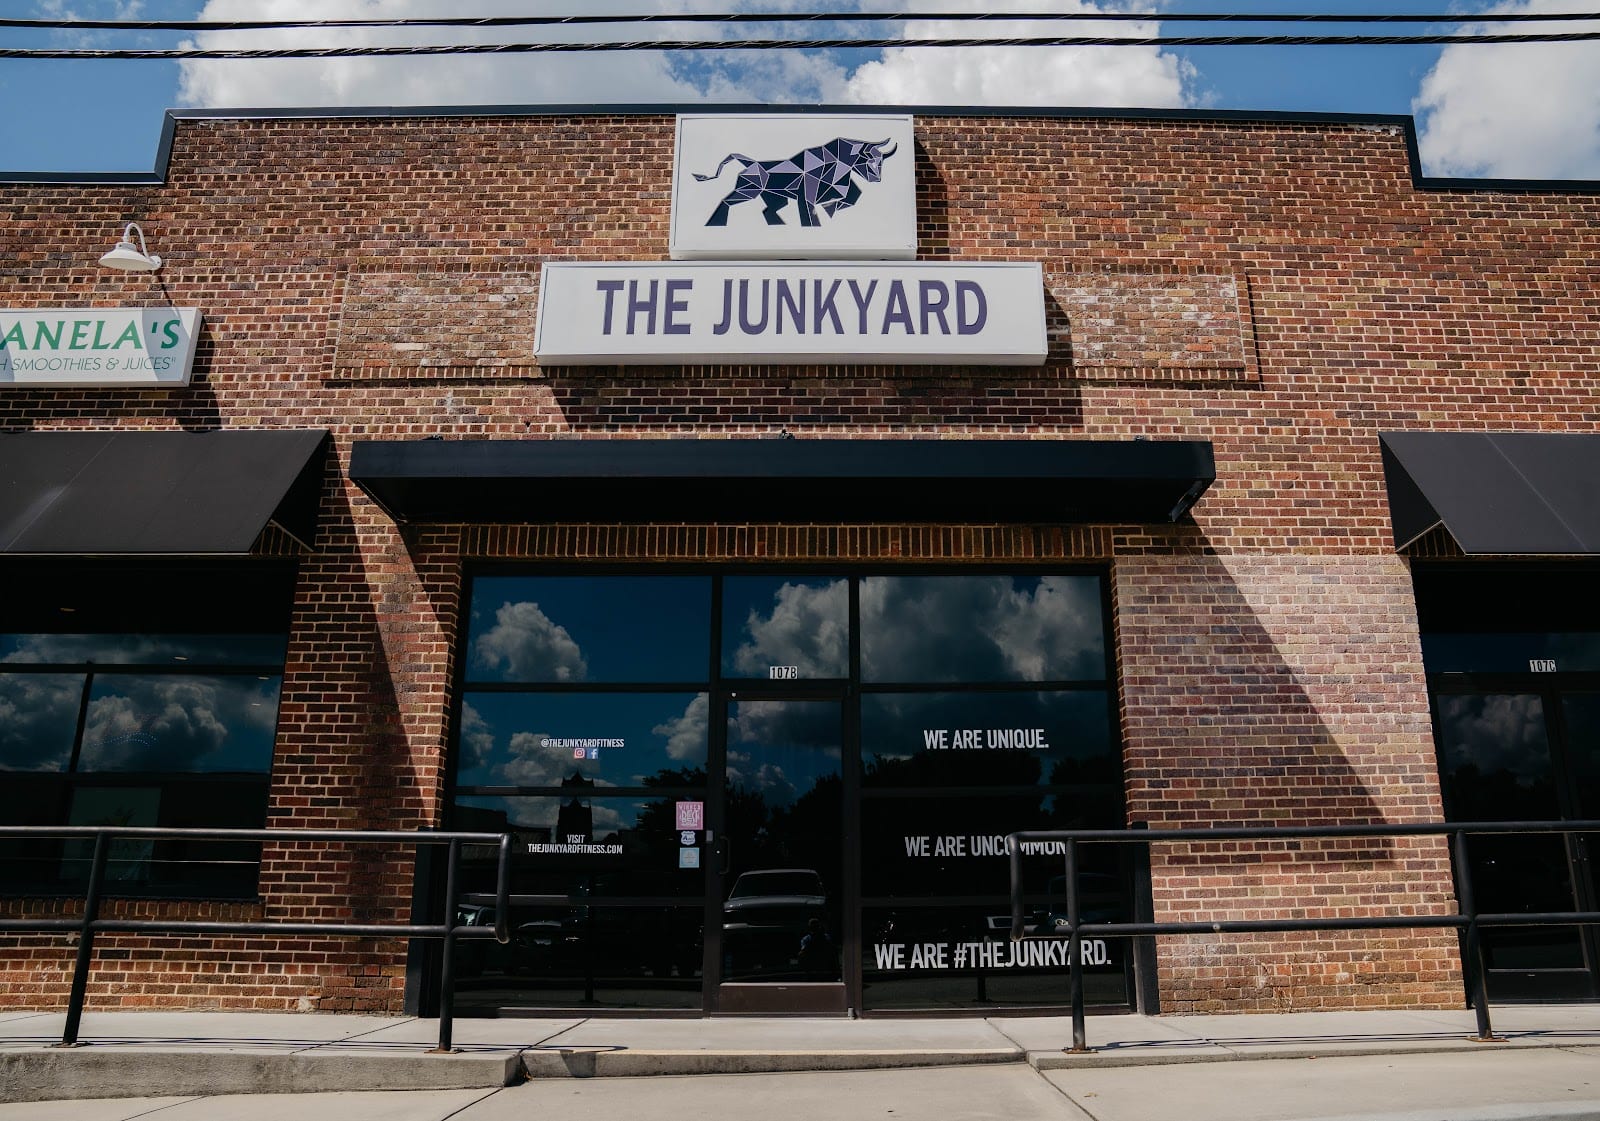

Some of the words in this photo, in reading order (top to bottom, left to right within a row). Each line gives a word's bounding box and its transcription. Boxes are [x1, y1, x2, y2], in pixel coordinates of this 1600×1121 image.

[597, 279, 693, 335] THE
[713, 279, 988, 336] JUNKYARD
[0, 319, 181, 351] ANELA'S
[11, 357, 101, 372] SMOOTHIES
[105, 357, 120, 371] &
[771, 667, 797, 679] 107B
[1531, 660, 1556, 672] 107C
[540, 738, 625, 748] @THEJUNKYARDFITNESS
[924, 729, 949, 750] WE
[952, 729, 983, 750] ARE
[987, 728, 1050, 750] UNIQUE.
[567, 834, 586, 844] VISIT
[904, 835, 931, 857] WE
[934, 835, 966, 857] ARE
[527, 843, 623, 854] THEJUNKYARDFITNESS.COM
[874, 943, 906, 970] WE
[910, 942, 949, 969] ARE
[953, 939, 1112, 969] #THEJUNKYRD.
